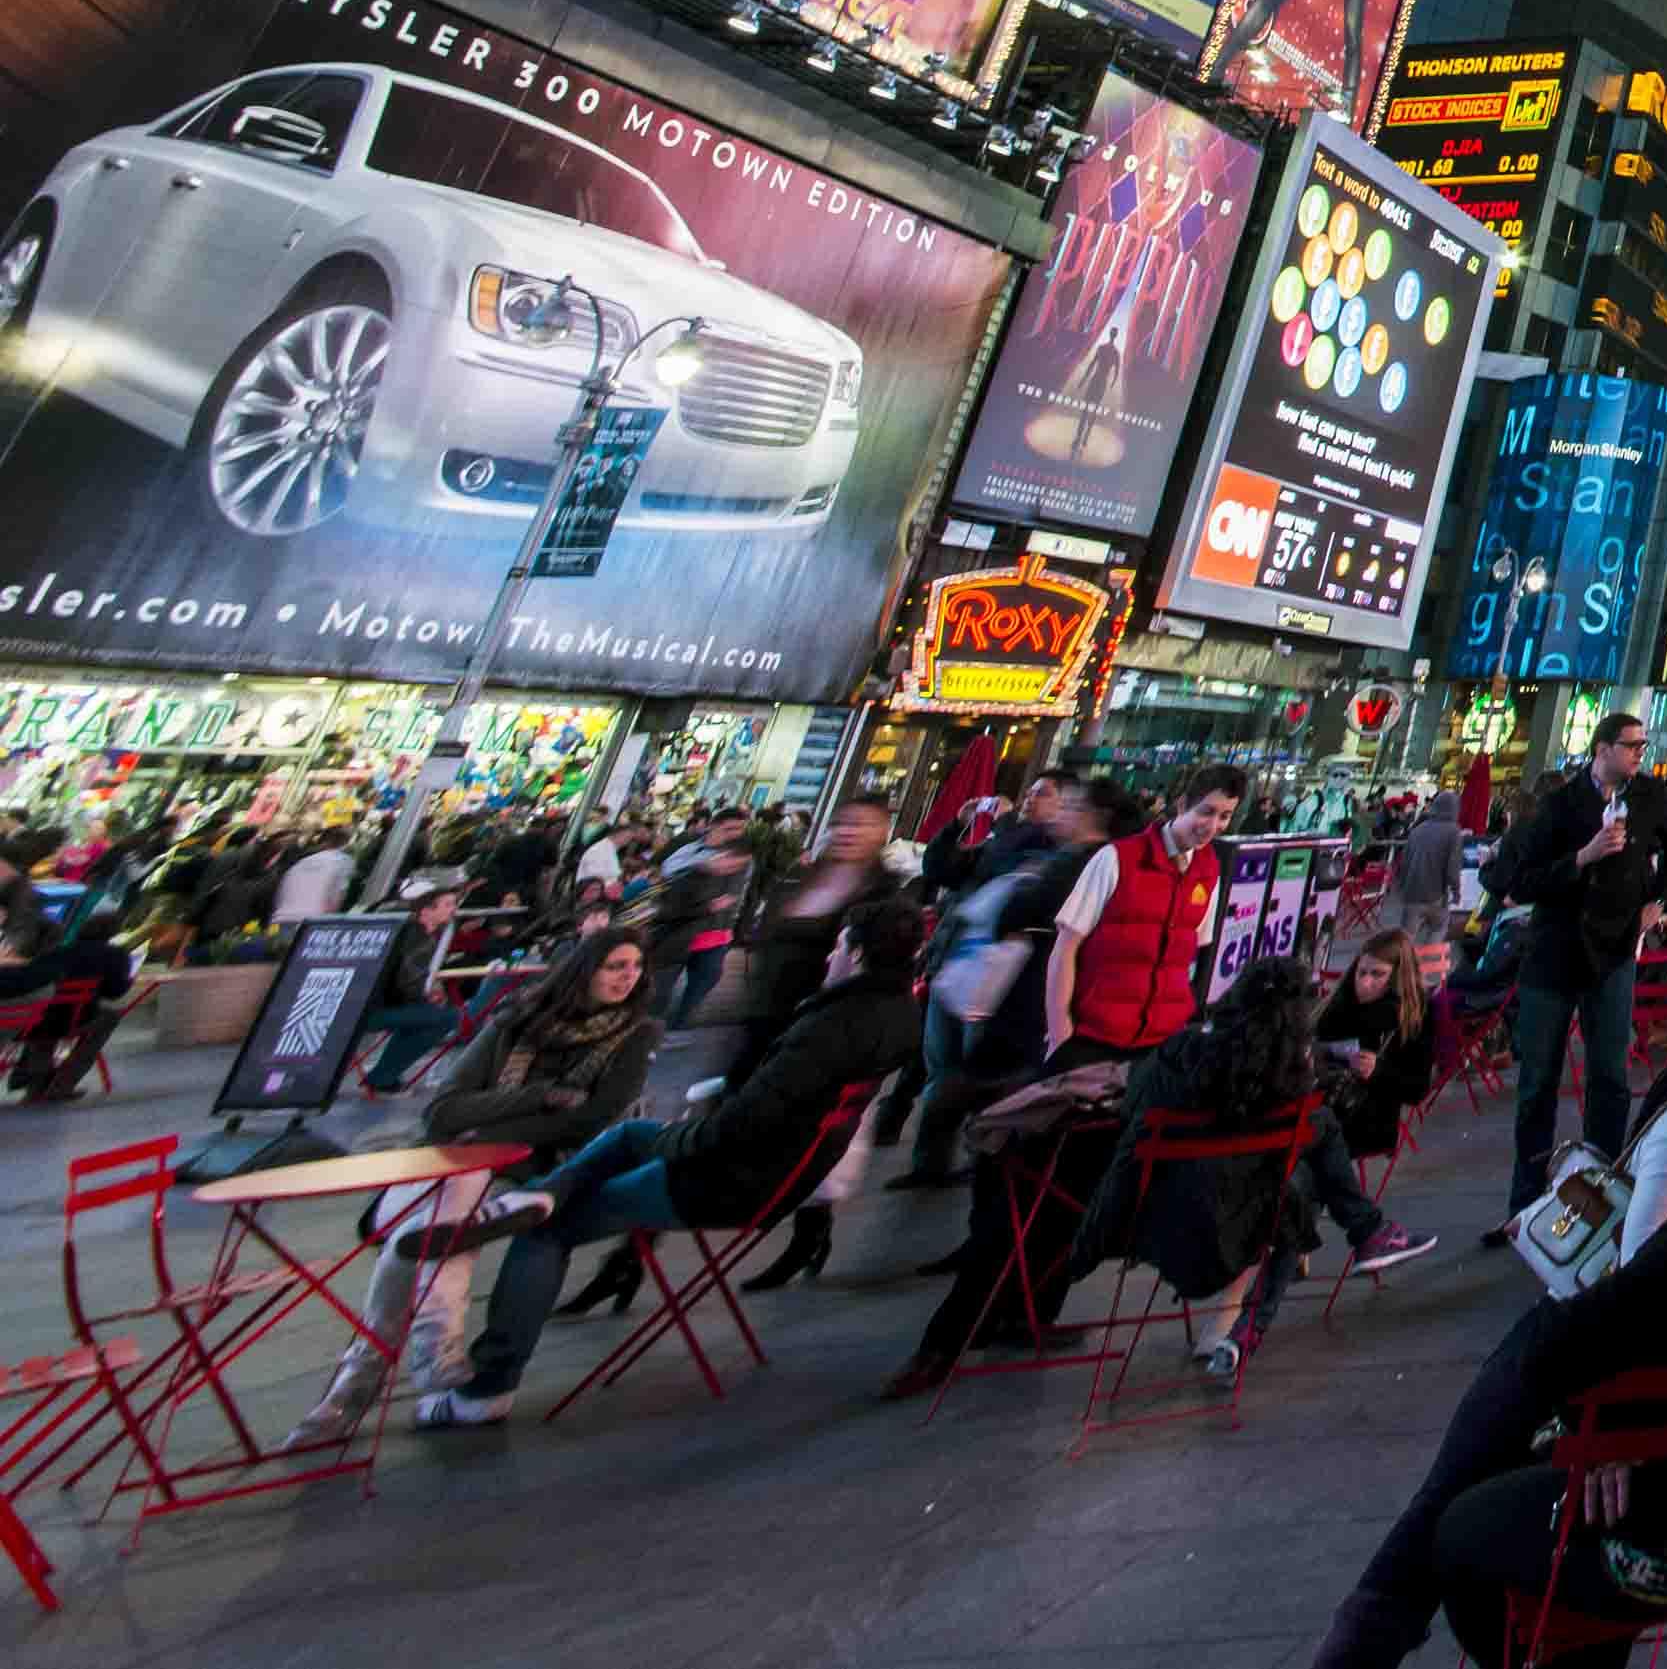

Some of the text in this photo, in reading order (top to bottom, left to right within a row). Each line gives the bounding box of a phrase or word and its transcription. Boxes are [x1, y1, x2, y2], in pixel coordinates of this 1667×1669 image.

[1407, 52, 1566, 78] THOMSON REUTERS
[1393, 98, 1503, 120] STOCK INDICES
[514, 57, 602, 115] 300
[623, 104, 793, 191] MOTOWN
[806, 180, 938, 254] EDITION
[1498, 154, 1539, 172] 0.00
[1313, 152, 1336, 181] Text
[1343, 176, 1369, 201] word
[1369, 191, 1380, 209] to
[1549, 439, 1643, 465] Morgan Stanley
[945, 675, 1042, 692] DELICATESSEN
